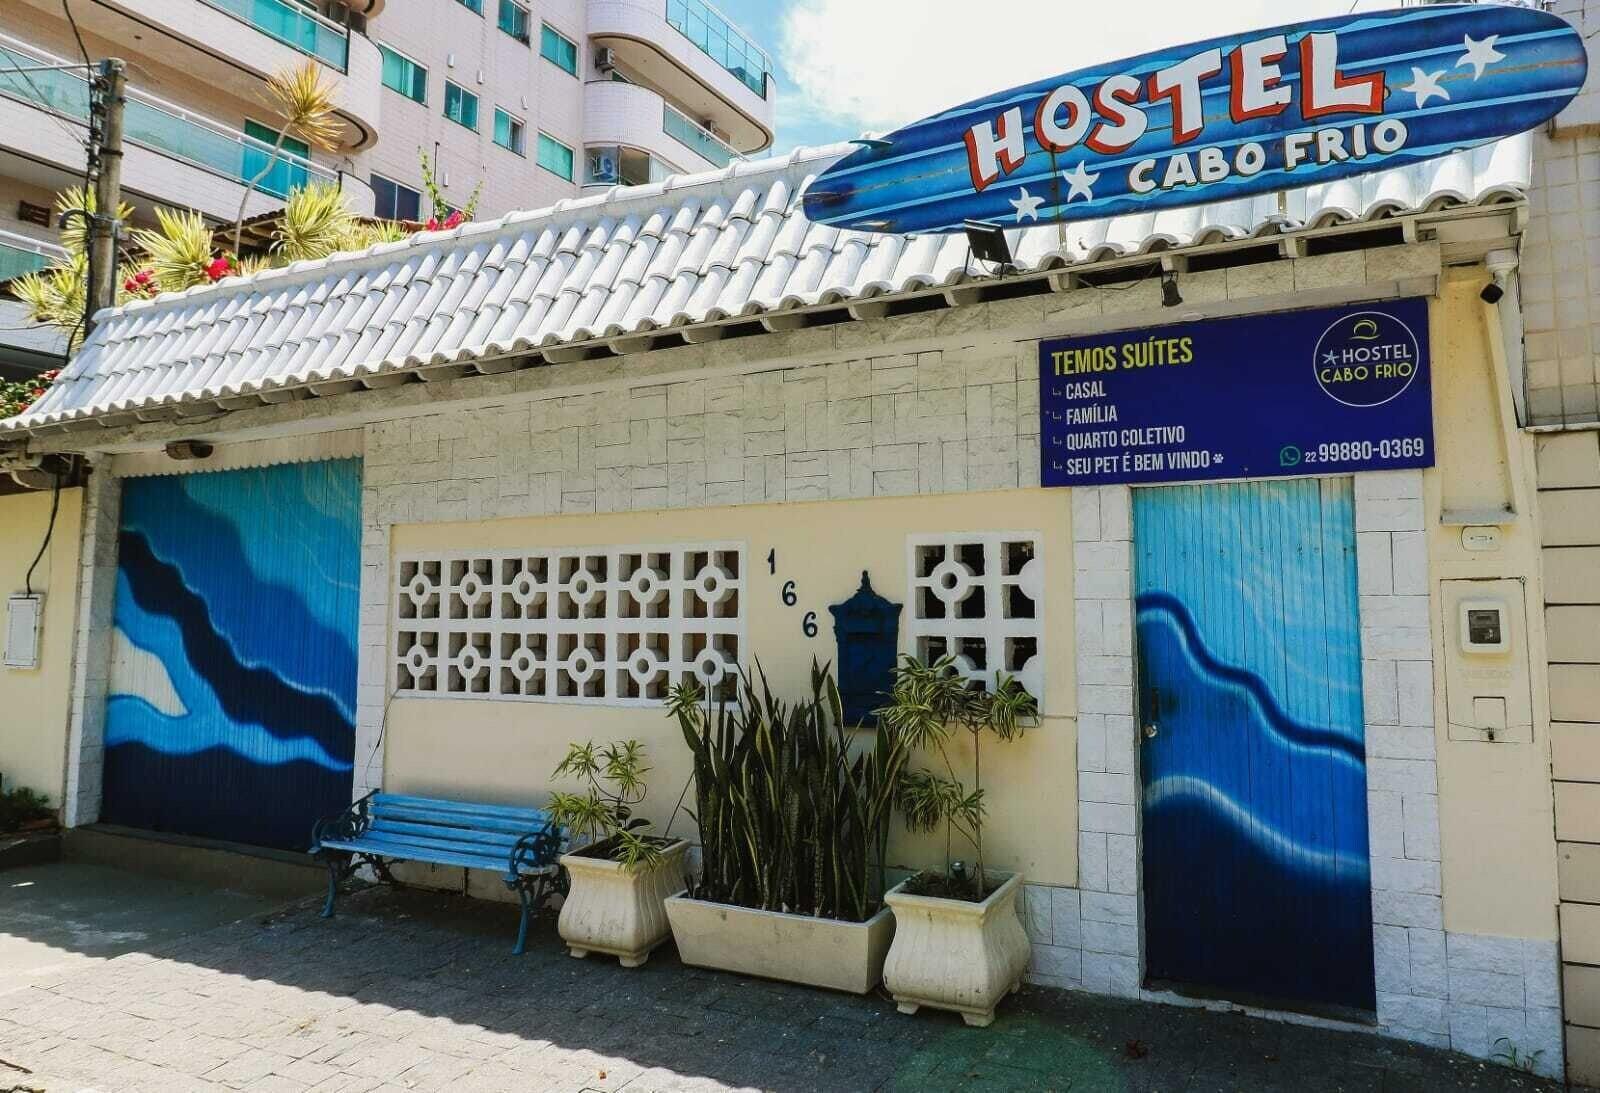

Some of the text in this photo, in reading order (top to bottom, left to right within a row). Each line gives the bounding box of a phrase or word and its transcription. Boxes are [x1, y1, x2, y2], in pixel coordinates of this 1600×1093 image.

[964, 31, 1387, 193] HOSTEL
[1127, 118, 1409, 193] CABO FRIO
[1051, 336, 1193, 376] TEMOS SUÍTES
[1342, 343, 1412, 364] HOSTEL
[1320, 362, 1412, 383] CABO FRIO
[1065, 380, 1107, 400] CASAL
[1066, 403, 1118, 425] FAMÍLIA
[1066, 425, 1185, 451] QUARTO COLETIVO
[1304, 437, 1425, 463] 22 99880-0369
[1067, 450, 1210, 475] SEU PET É BEM VINDO
